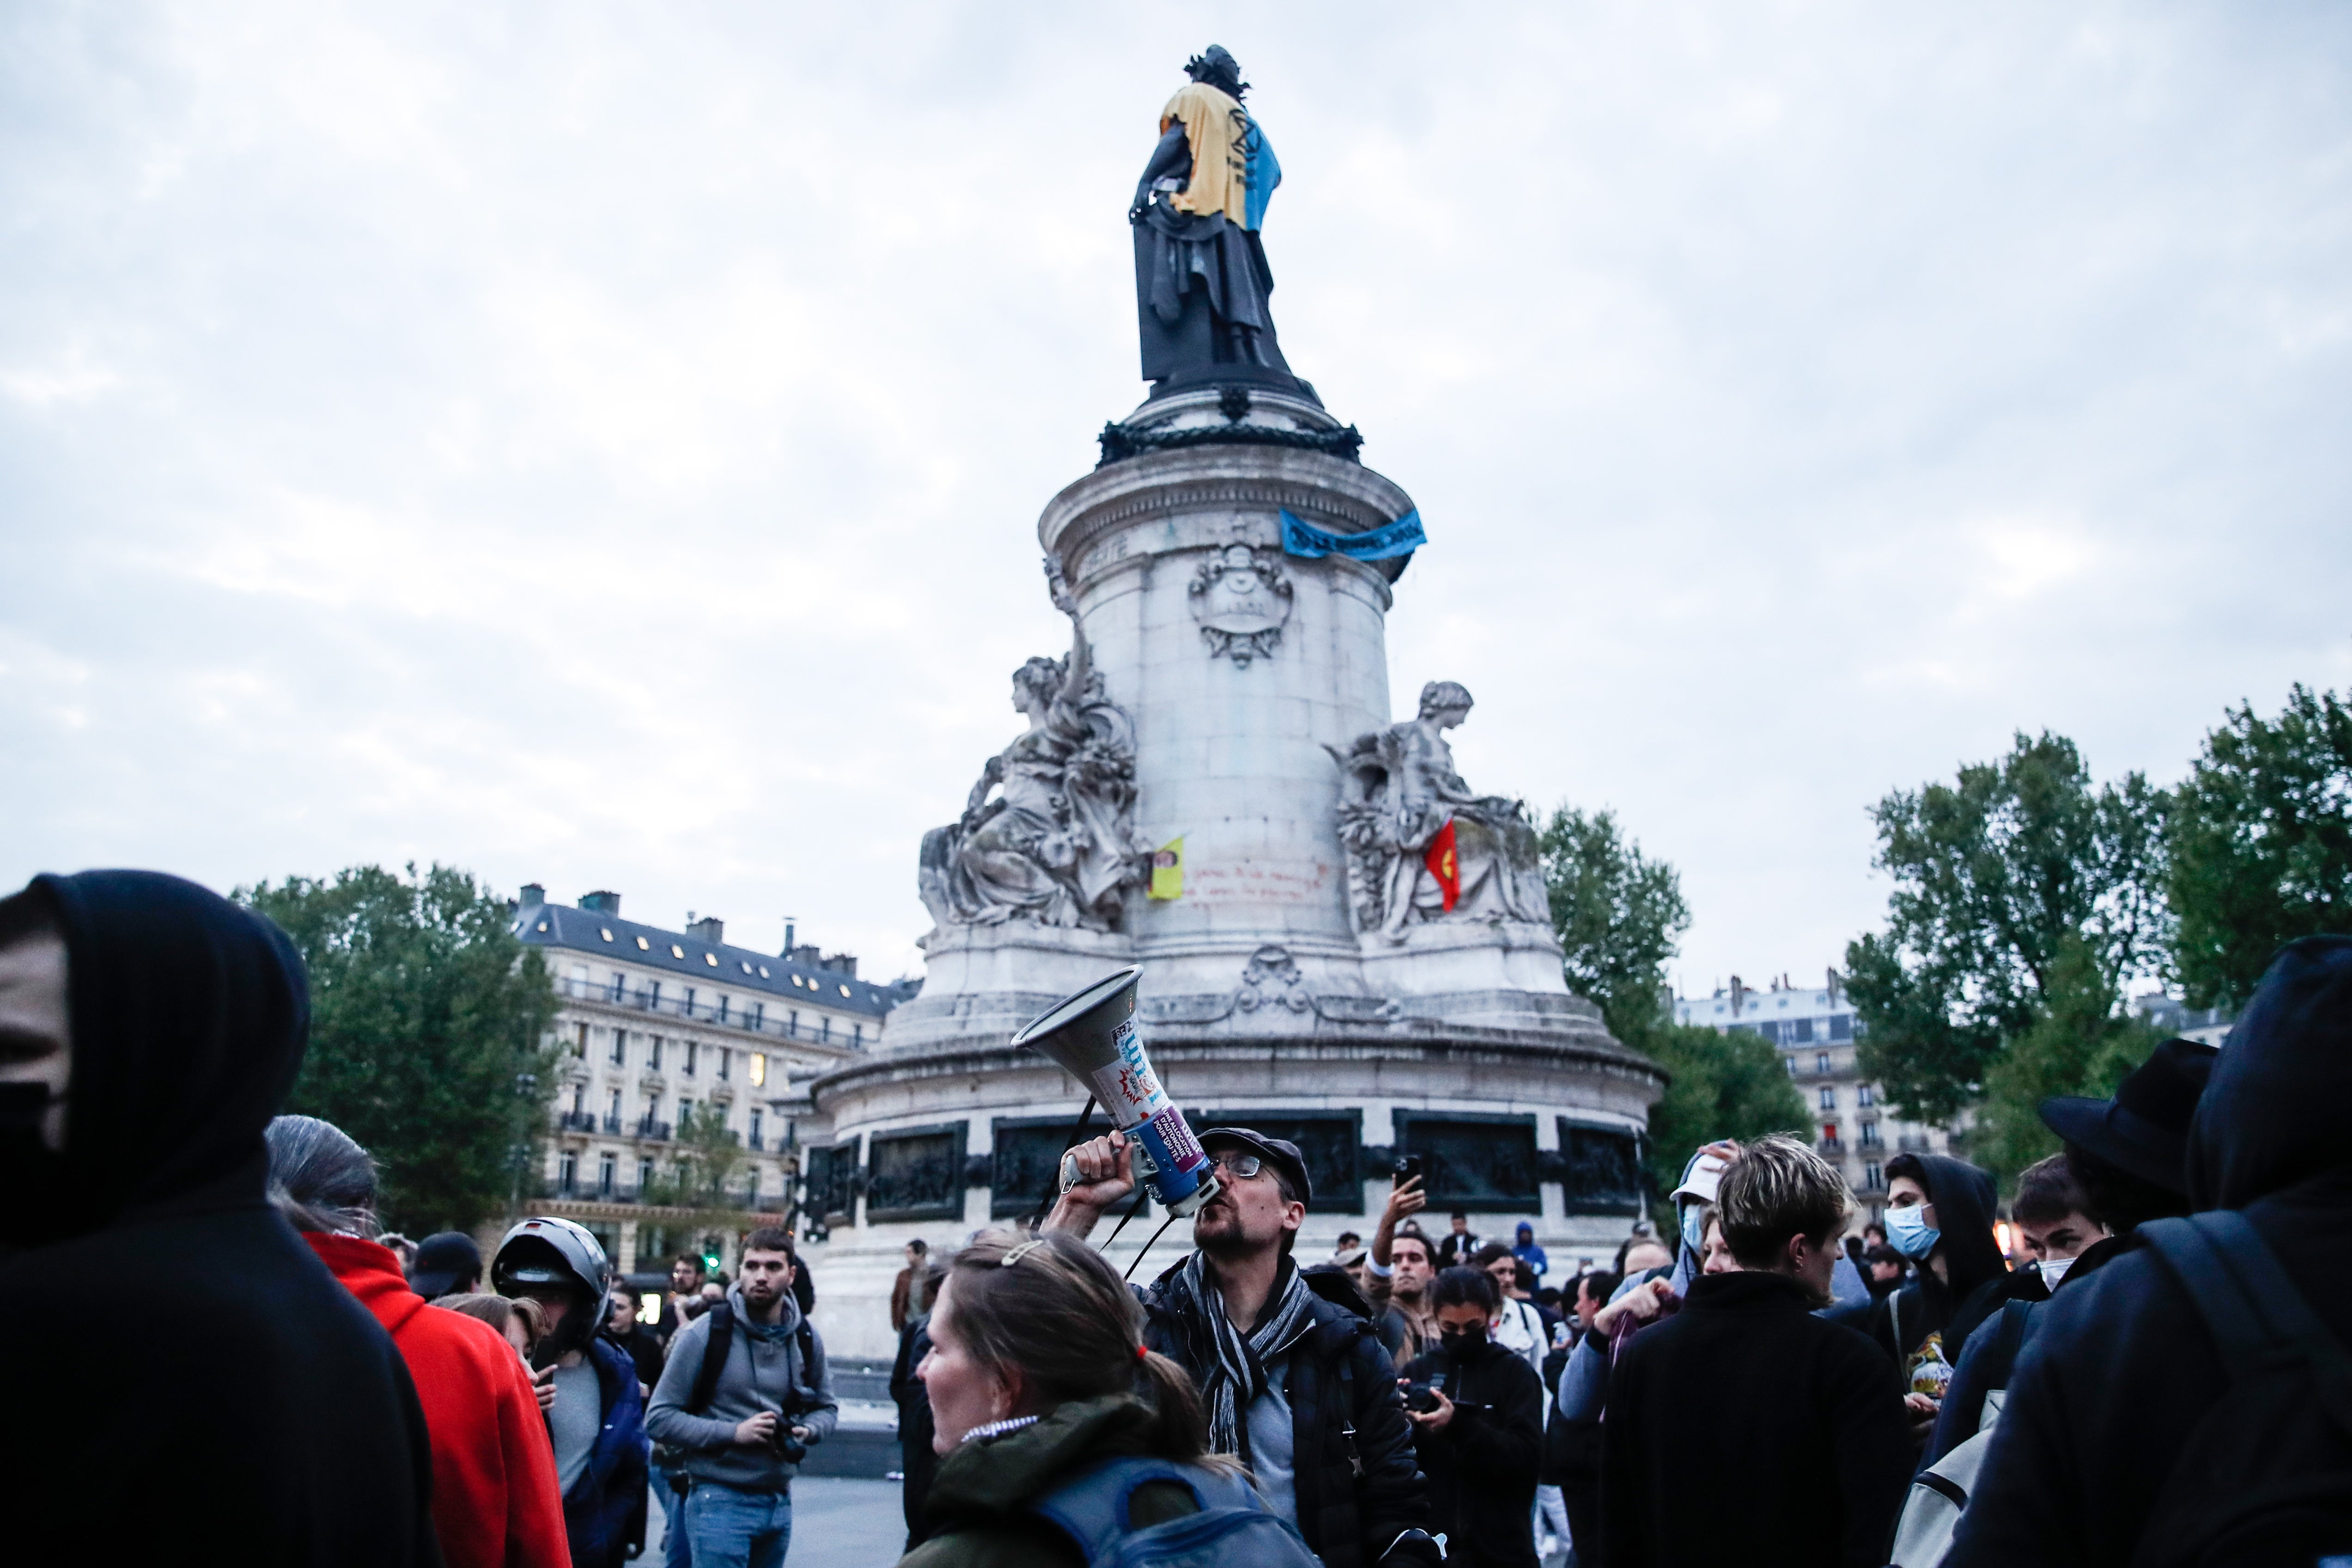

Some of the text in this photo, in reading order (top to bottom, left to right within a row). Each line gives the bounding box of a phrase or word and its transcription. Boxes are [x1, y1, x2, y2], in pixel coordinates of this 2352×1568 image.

[1153, 1119, 1167, 1138] POUR
[1160, 1116, 1186, 1157] D'AUTONOMIE
[1163, 1109, 1193, 1158] UNE ALLOCATION
